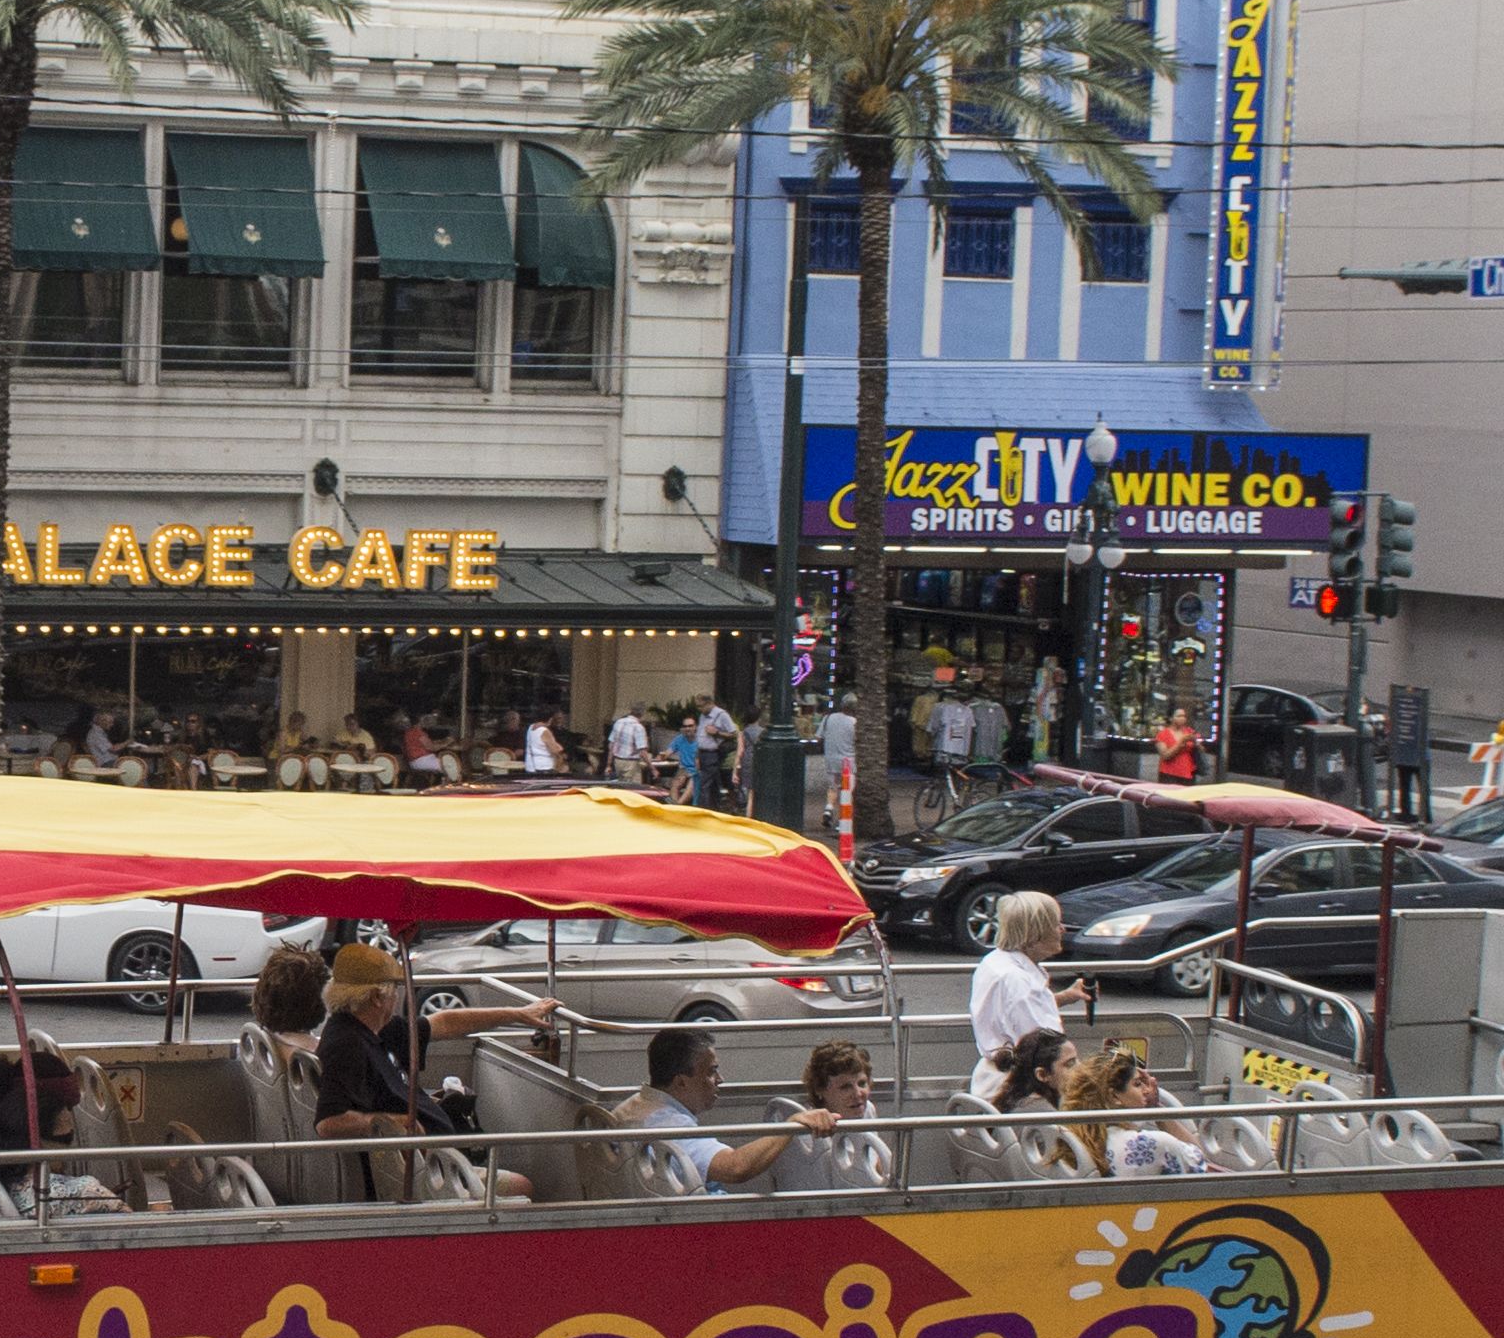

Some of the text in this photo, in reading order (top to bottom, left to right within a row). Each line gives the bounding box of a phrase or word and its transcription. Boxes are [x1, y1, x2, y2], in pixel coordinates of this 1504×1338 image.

[1214, 348, 1251, 362] WINE
[1113, 472, 1232, 507] WINE
[1242, 474, 1316, 507] CO.
[911, 508, 1014, 532] SPIRITS
[1146, 510, 1262, 534] LUGGAGE
[290, 524, 499, 590] CAFE
[1291, 589, 1318, 605] AT
